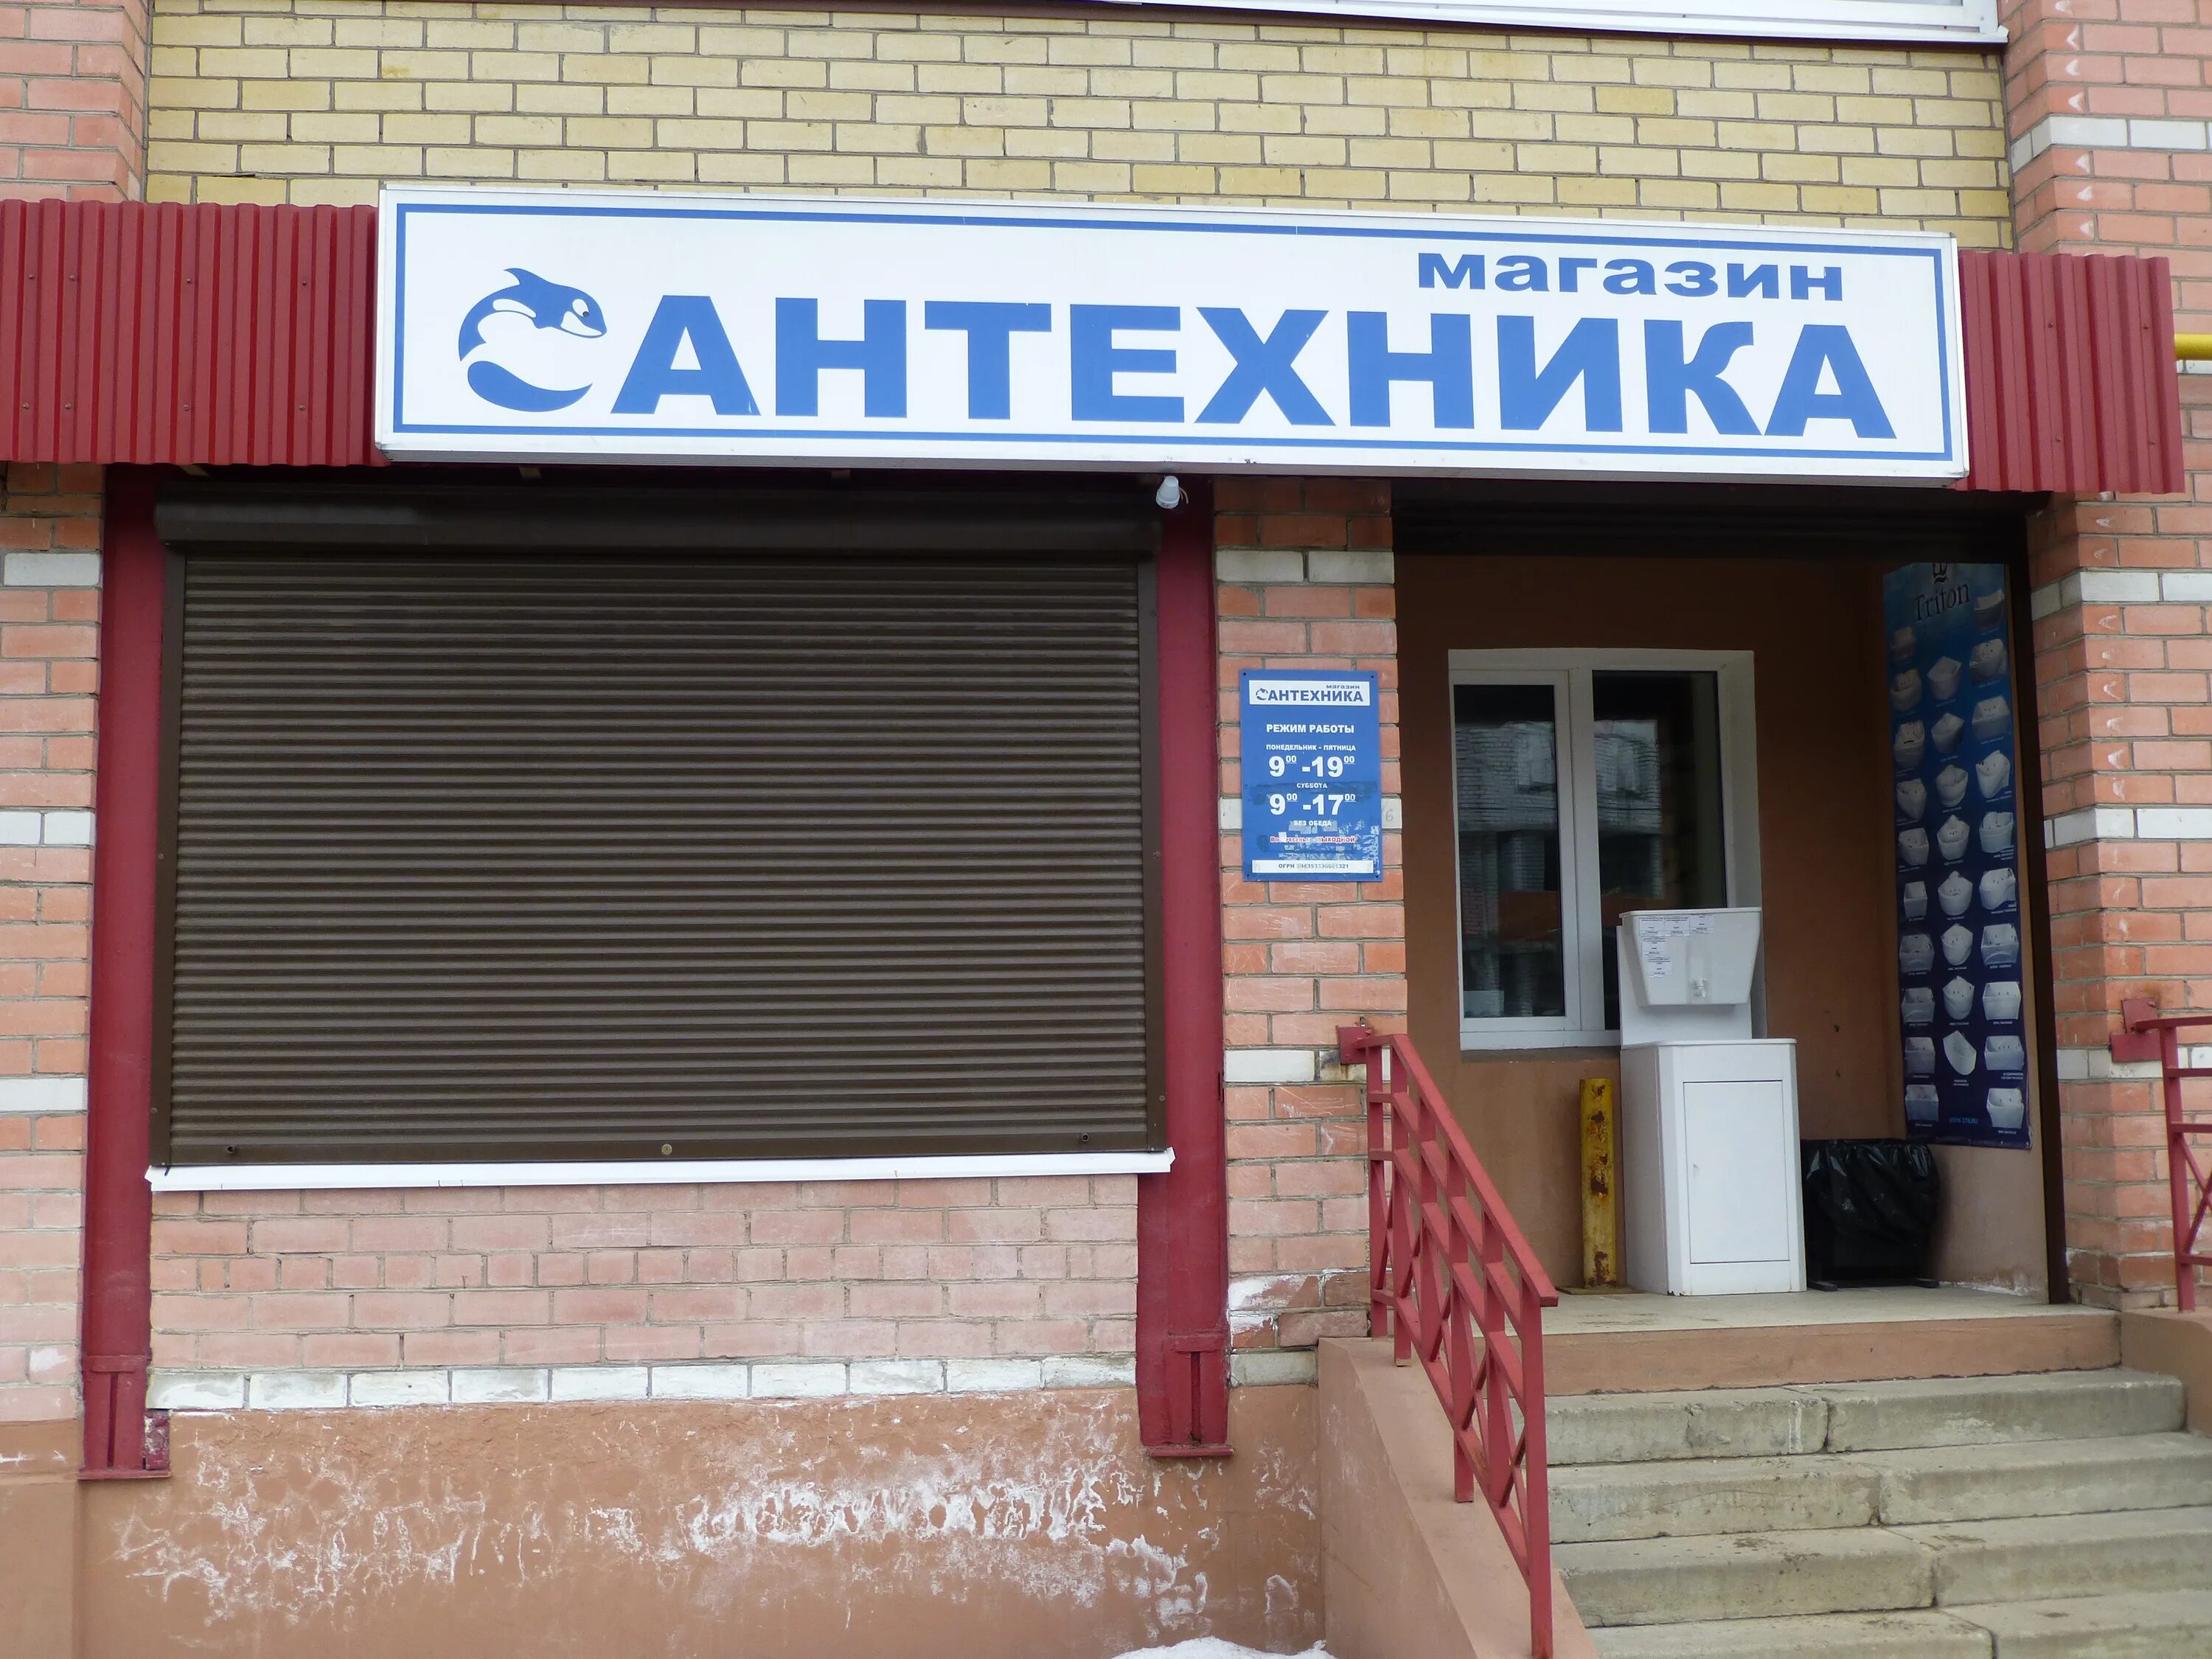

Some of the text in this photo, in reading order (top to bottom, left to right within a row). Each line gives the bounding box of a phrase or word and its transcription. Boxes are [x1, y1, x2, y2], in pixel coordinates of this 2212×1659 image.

[1418, 251, 1843, 302] магазин
[1913, 583, 1970, 621] Triton
[1266, 724, 1354, 734] РЕЖИМ РАБОТЫ
